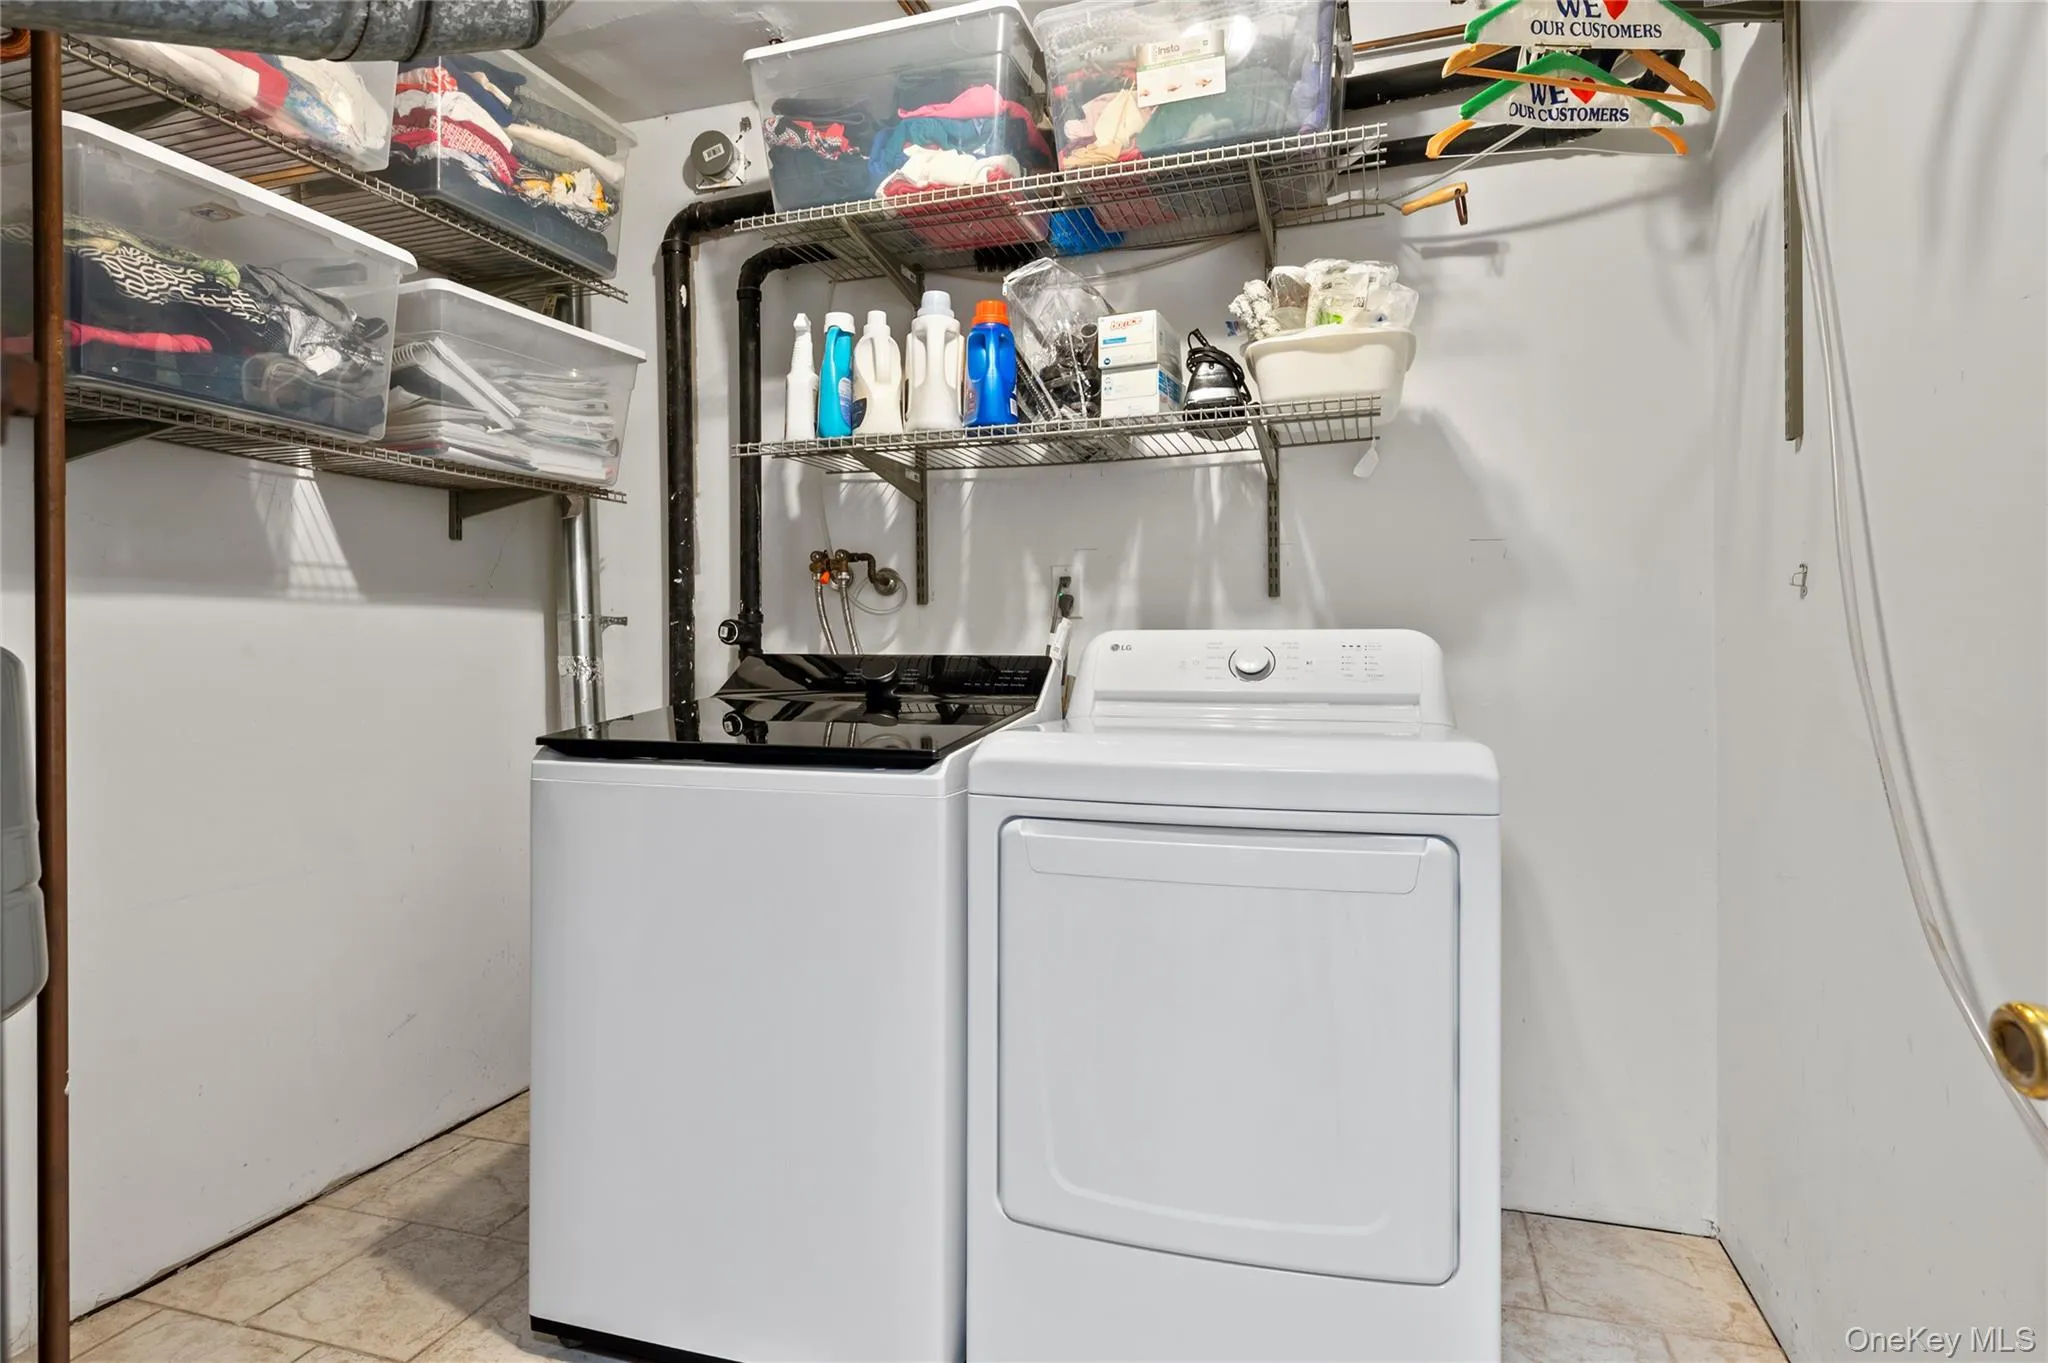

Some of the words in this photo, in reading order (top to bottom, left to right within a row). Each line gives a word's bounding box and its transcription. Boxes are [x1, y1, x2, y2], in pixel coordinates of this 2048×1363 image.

[1557, 0, 1602, 18] WE
[1531, 20, 1565, 36] OUR
[1570, 22, 1662, 38] CUSTOMERS
[1530, 83, 1568, 105] WE
[1509, 102, 1536, 119] OUR
[1538, 107, 1630, 122] CUSTOMERS
